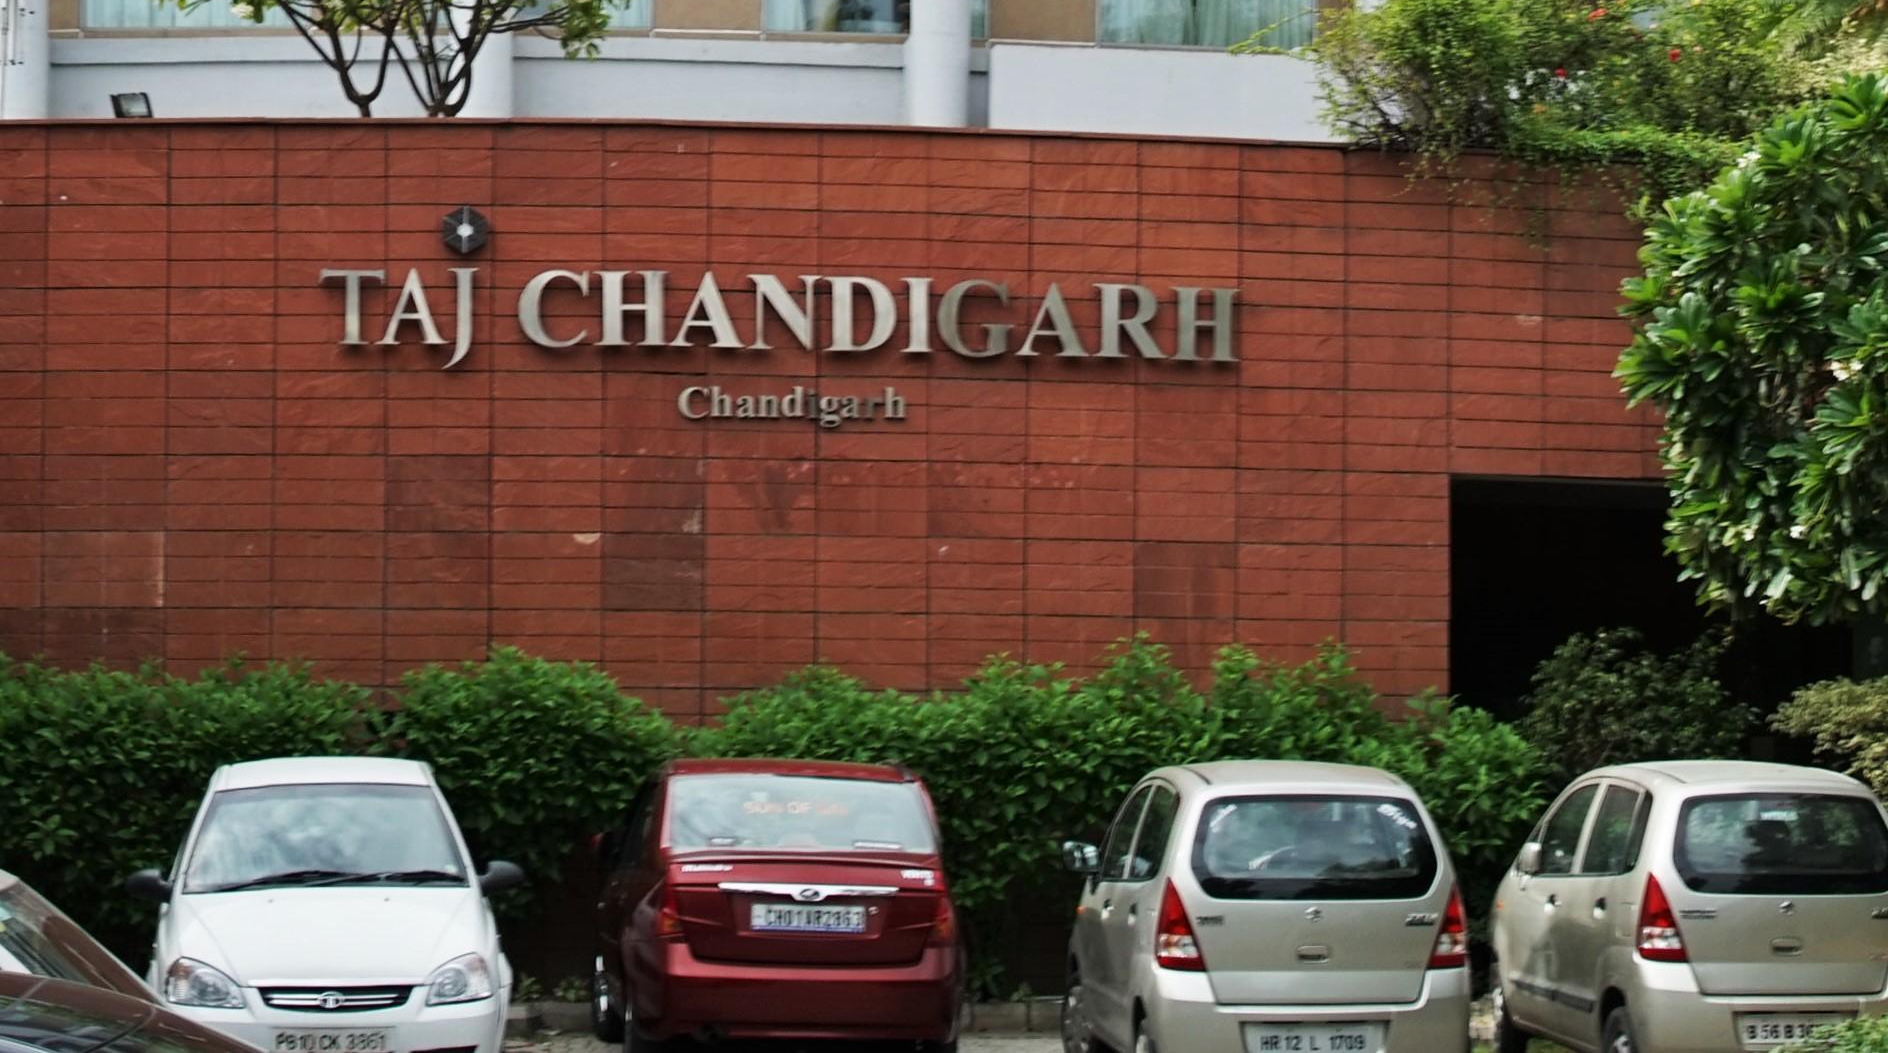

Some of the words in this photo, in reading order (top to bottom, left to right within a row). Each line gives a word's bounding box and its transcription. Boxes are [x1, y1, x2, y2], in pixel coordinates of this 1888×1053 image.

[319, 267, 479, 369] TAJ
[517, 269, 1243, 363] CHANDIGARH
[677, 386, 906, 428] Chandigarh
[1260, 1035, 1281, 1051] HR
[1284, 1035, 1303, 1051] 12
[1309, 1035, 1321, 1051] L
